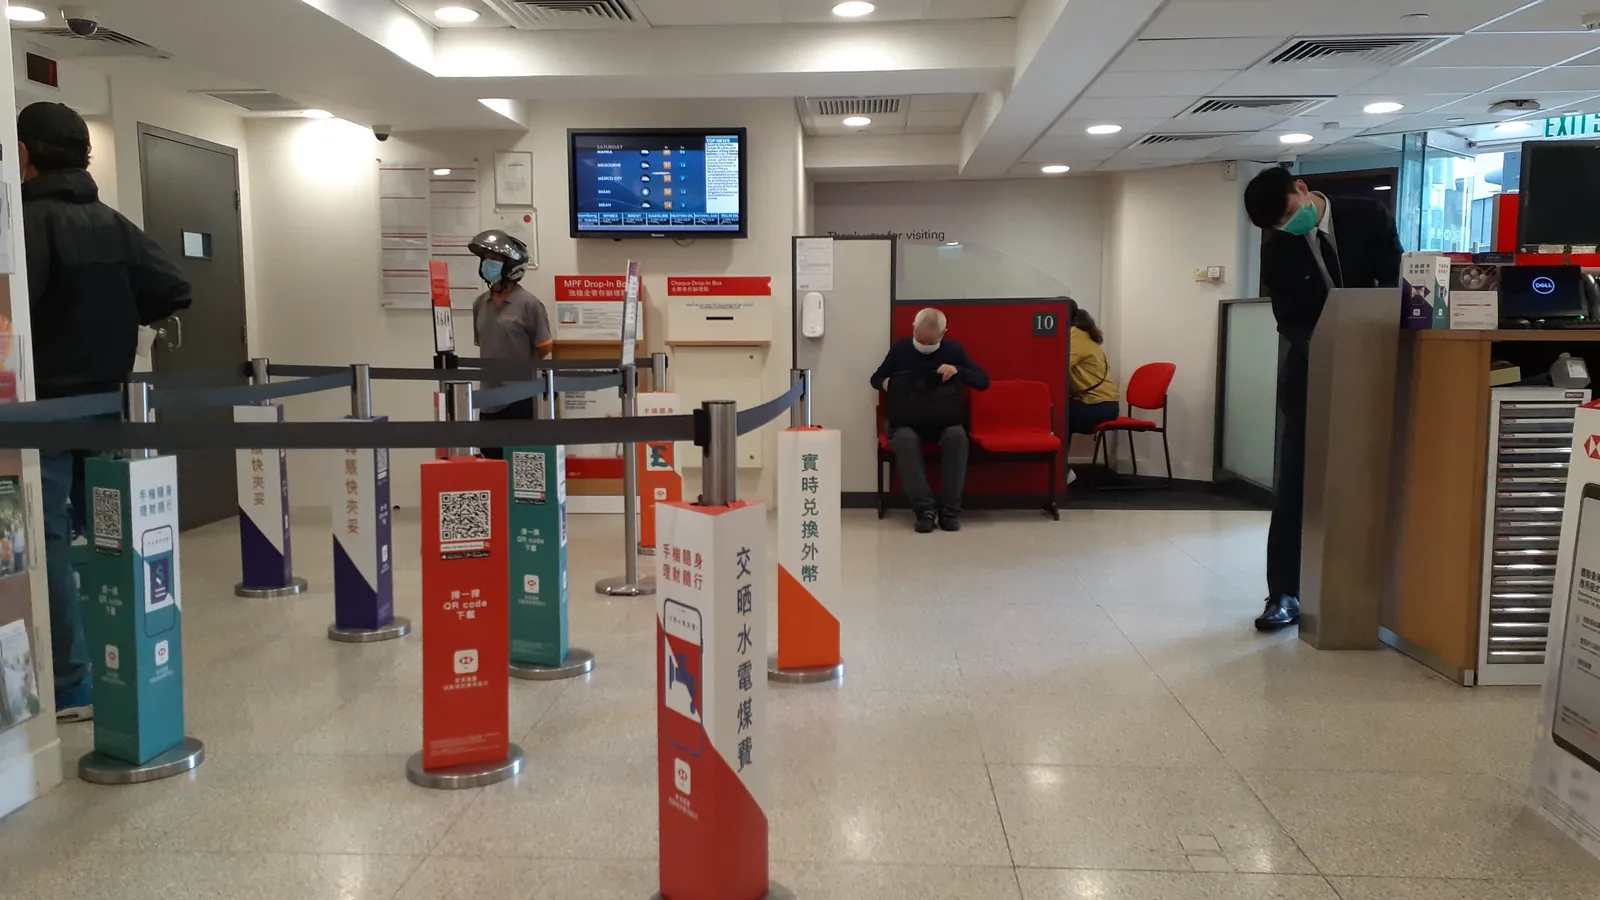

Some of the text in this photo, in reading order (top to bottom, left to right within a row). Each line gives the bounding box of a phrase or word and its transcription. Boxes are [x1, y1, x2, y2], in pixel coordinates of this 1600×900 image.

[1545, 114, 1586, 137] EXIT
[906, 229, 945, 241] visiting
[564, 280, 627, 290] MPF Drop-In Bo
[1036, 315, 1054, 330] 10
[443, 599, 488, 610] QR code
[736, 546, 753, 773] 交晒水電煤費
